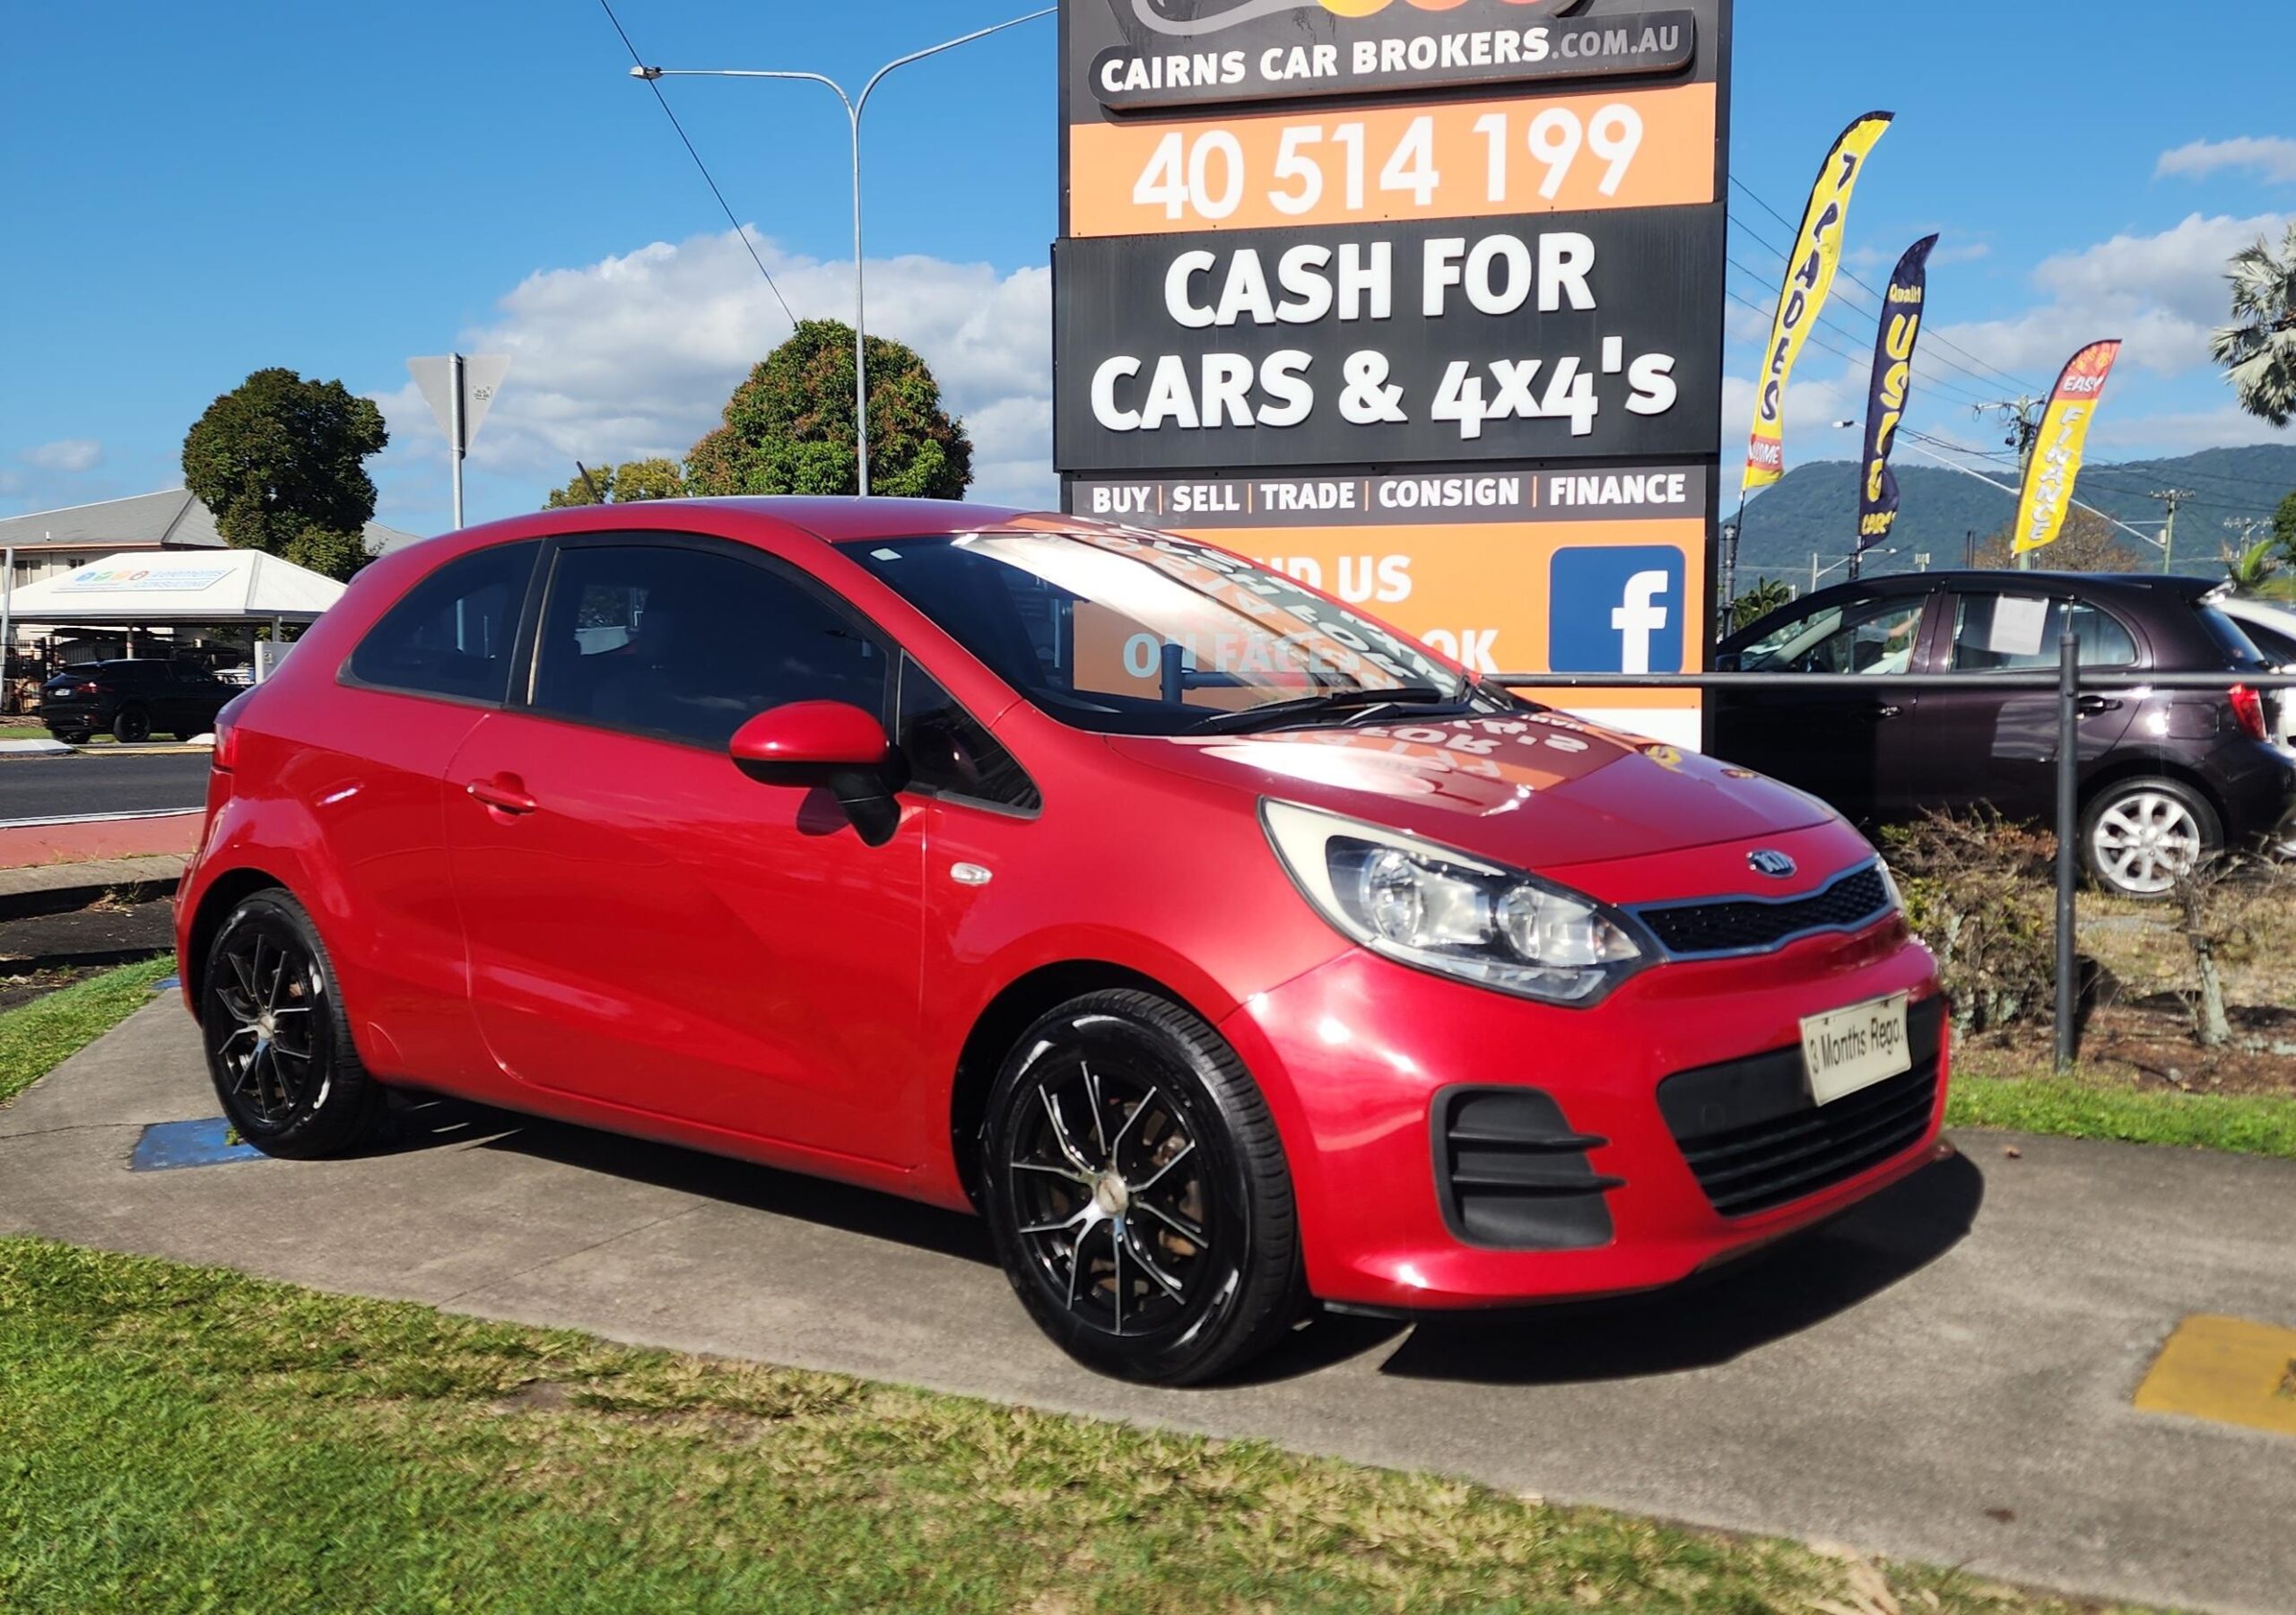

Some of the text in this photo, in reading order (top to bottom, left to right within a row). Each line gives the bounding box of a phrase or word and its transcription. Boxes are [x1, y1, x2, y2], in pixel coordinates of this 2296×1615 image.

[1100, 50, 1246, 92] CAIRNS
[1259, 44, 1338, 81] CAR
[1133, 104, 1643, 219] 40 514 199
[1164, 231, 1596, 327] CASH FOR
[1091, 350, 1314, 430] CARS
[1339, 350, 1408, 424] &
[2063, 375, 2104, 393] EASY
[1091, 473, 1686, 514] BUY SELL TRADE CONSIGN FINANCE
[2029, 407, 2084, 541] FINANCE
[1338, 554, 1413, 603] US
[1810, 1038, 1821, 1074] 3
[1821, 1024, 1866, 1070] Months
